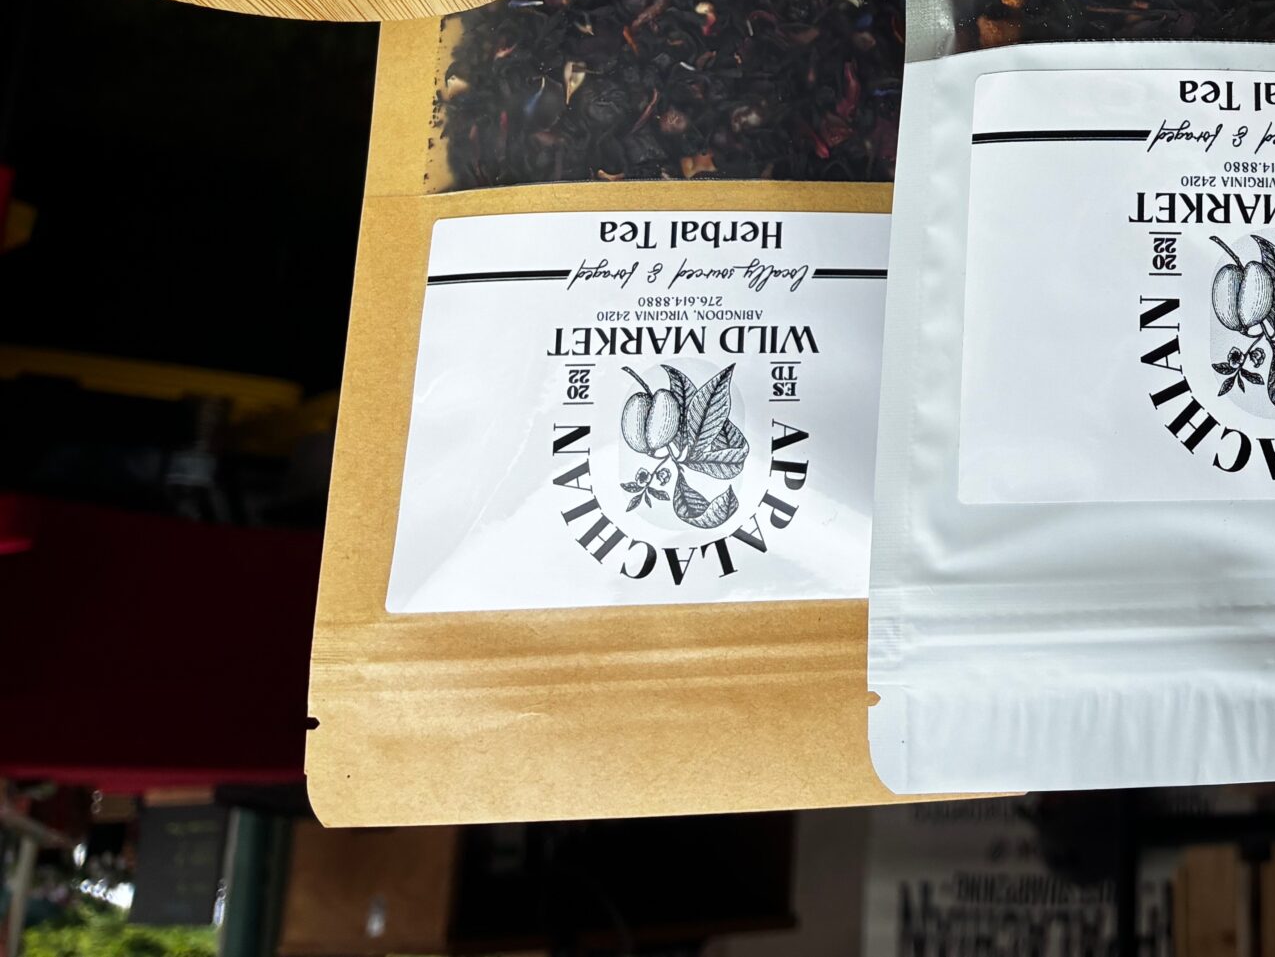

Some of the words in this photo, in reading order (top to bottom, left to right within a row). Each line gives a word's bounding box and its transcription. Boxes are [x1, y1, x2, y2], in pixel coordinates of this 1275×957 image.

[1179, 80, 1241, 111] Tea
[1146, 119, 1223, 153] foraged
[1232, 126, 1248, 147] &
[1180, 175, 1217, 187] 24210
[599, 221, 657, 249] Tea
[670, 221, 783, 249] Herbal
[1153, 237, 1177, 254] 22
[647, 263, 663, 283] &
[668, 258, 736, 290] sourced
[1152, 254, 1177, 270] 20
[567, 259, 640, 291] foraged
[732, 258, 809, 293] locally
[638, 296, 723, 308] 276.614.8880
[596, 311, 631, 322] 24210
[634, 310, 689, 322] VIRGINIA
[547, 327, 706, 356] MARKET
[719, 325, 820, 355] WILD
[568, 369, 591, 384] 22
[566, 385, 591, 400] 20
[552, 418, 809, 586] APPALACHIAN
